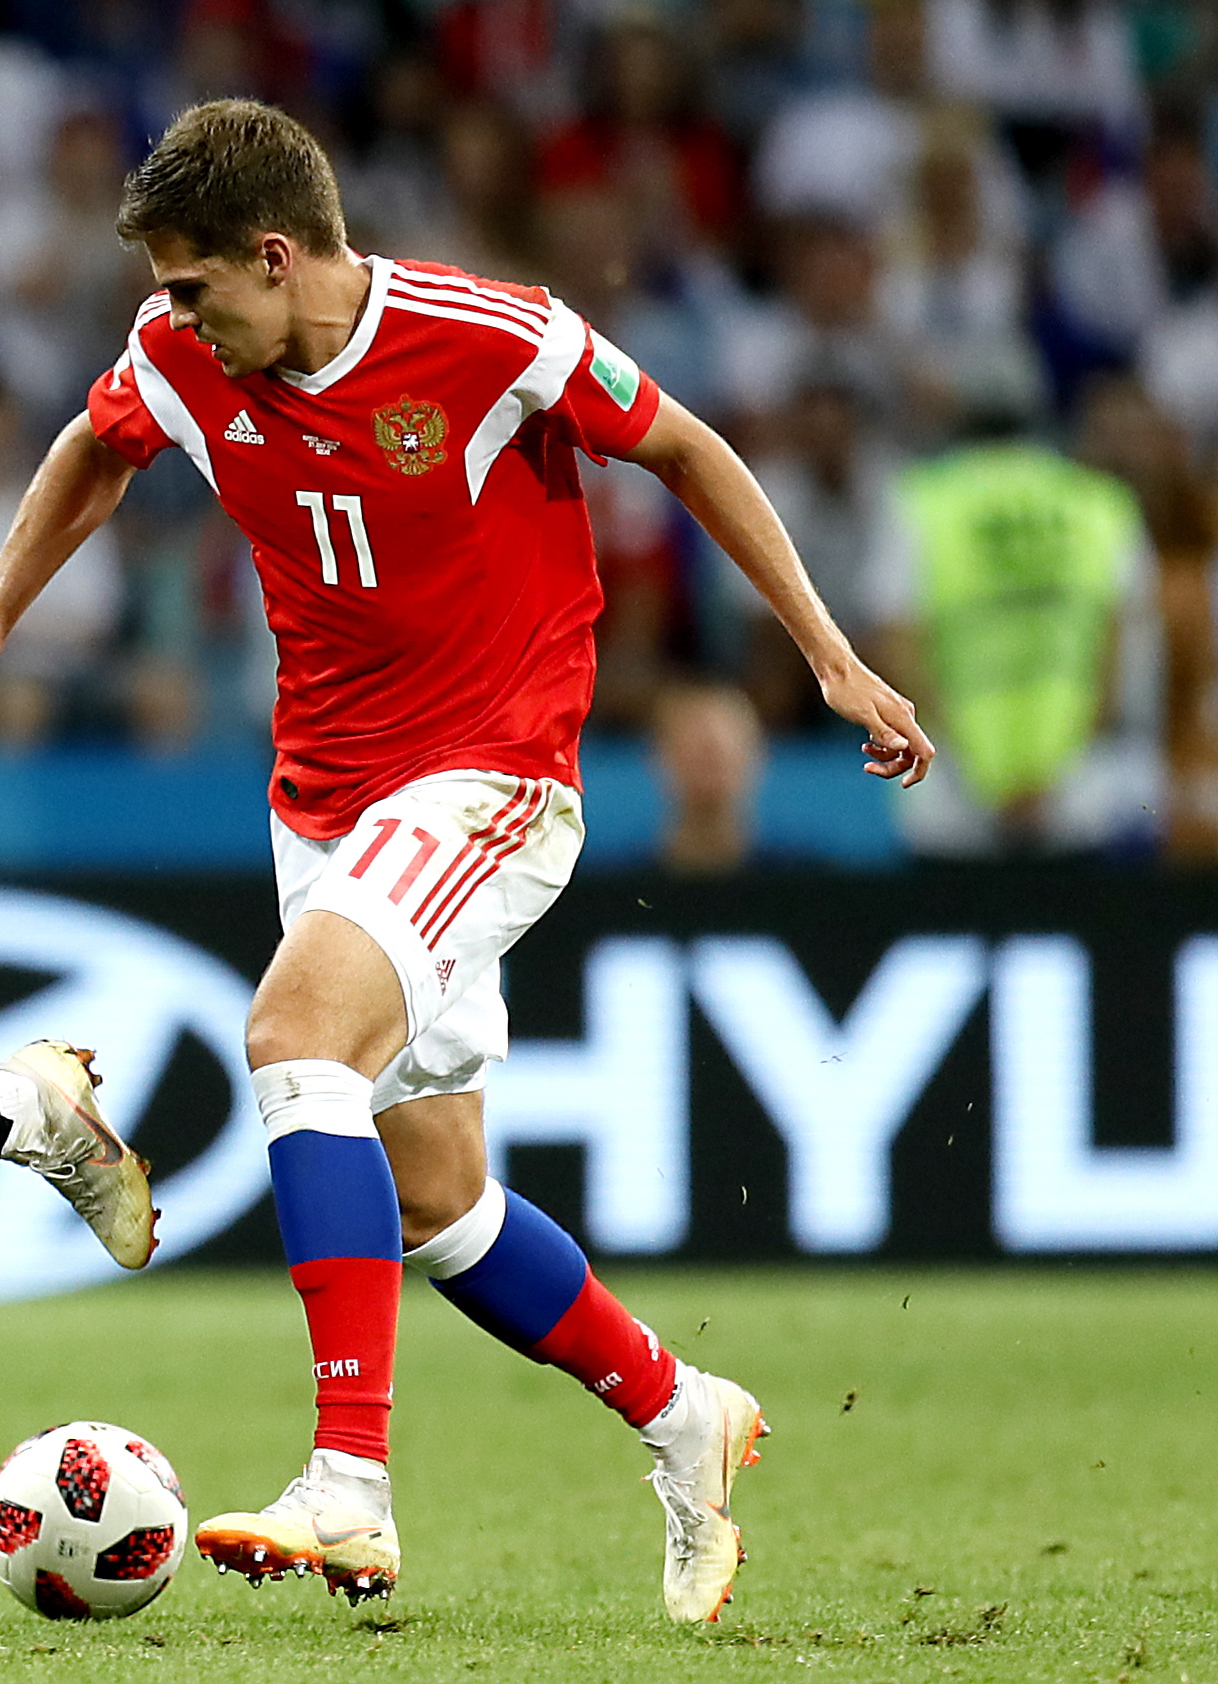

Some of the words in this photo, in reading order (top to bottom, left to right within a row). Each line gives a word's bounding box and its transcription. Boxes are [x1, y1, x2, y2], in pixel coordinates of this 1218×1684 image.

[224, 430, 265, 445] adidas
[295, 490, 378, 588] 11
[348, 818, 442, 907] 11
